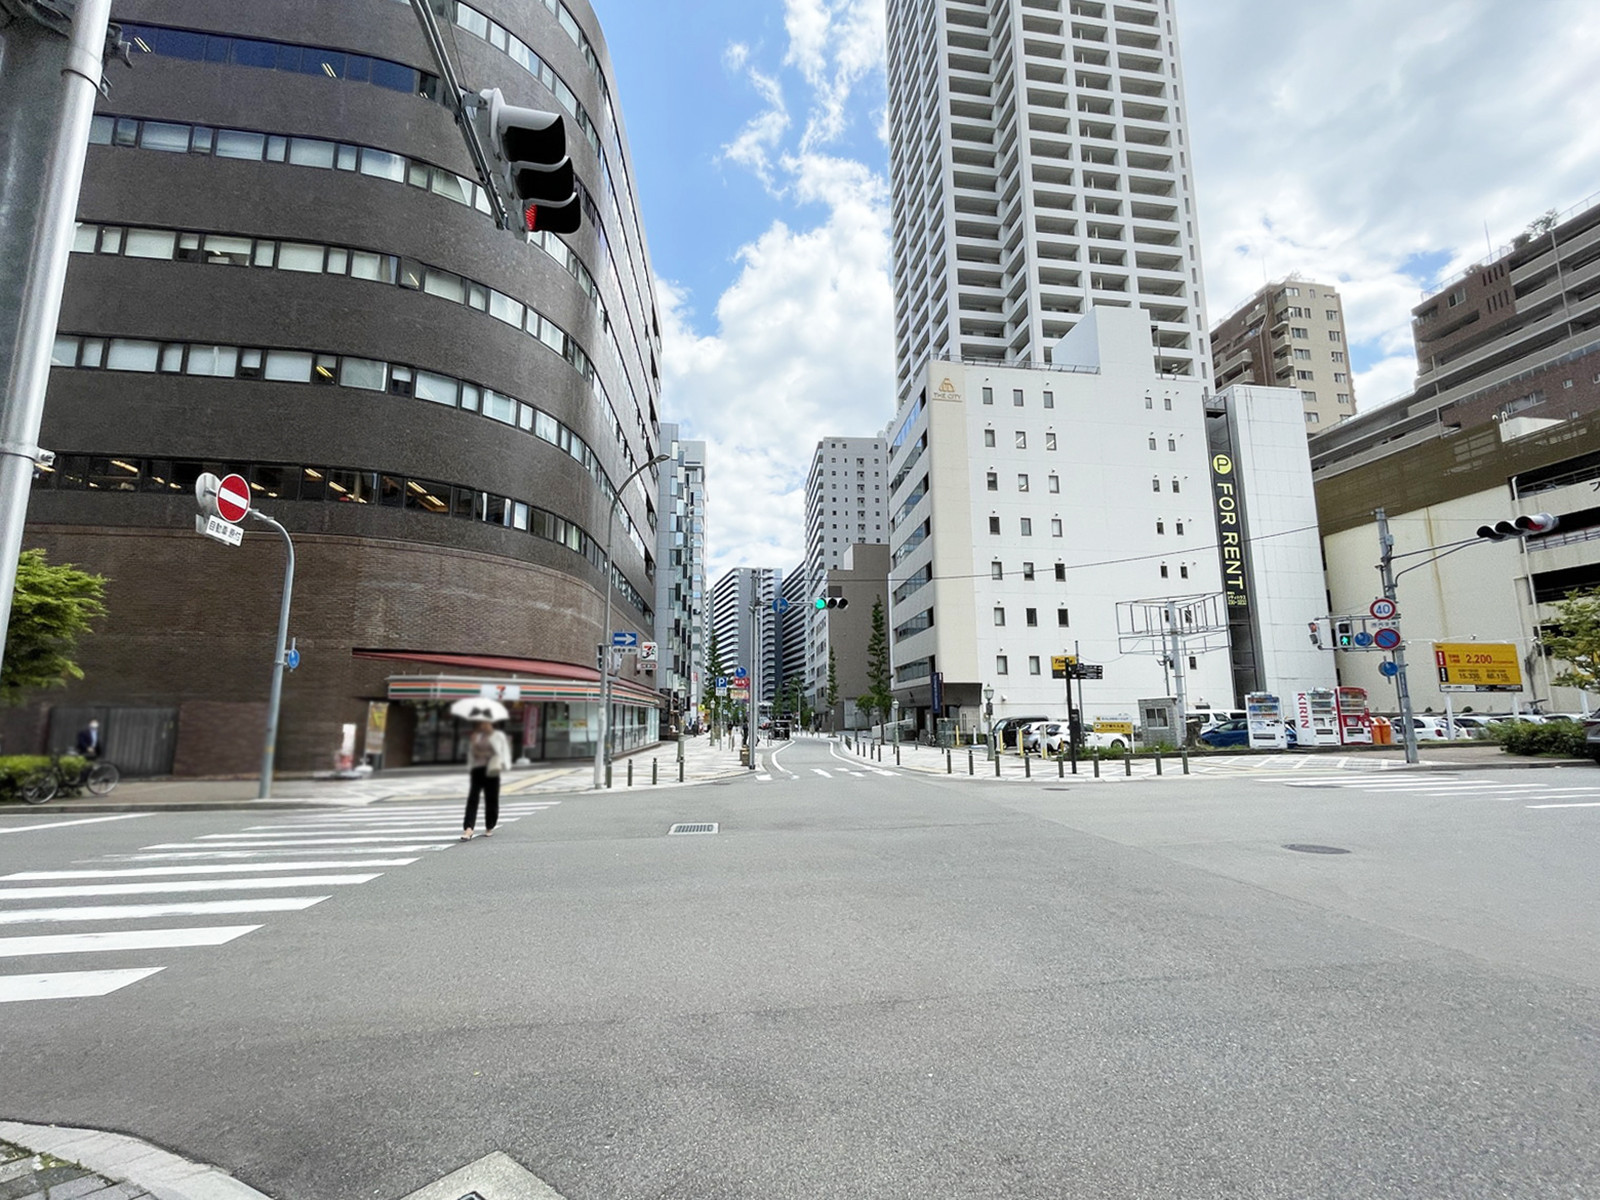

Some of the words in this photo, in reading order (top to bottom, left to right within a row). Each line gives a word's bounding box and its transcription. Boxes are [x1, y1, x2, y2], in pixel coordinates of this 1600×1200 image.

[1215, 456, 1230, 472] P
[1217, 482, 1236, 525] FOR
[1222, 532, 1244, 590] RENT
[1376, 604, 1391, 614] 40
[718, 677, 725, 687] P
[1298, 693, 1309, 728] KIRIN
